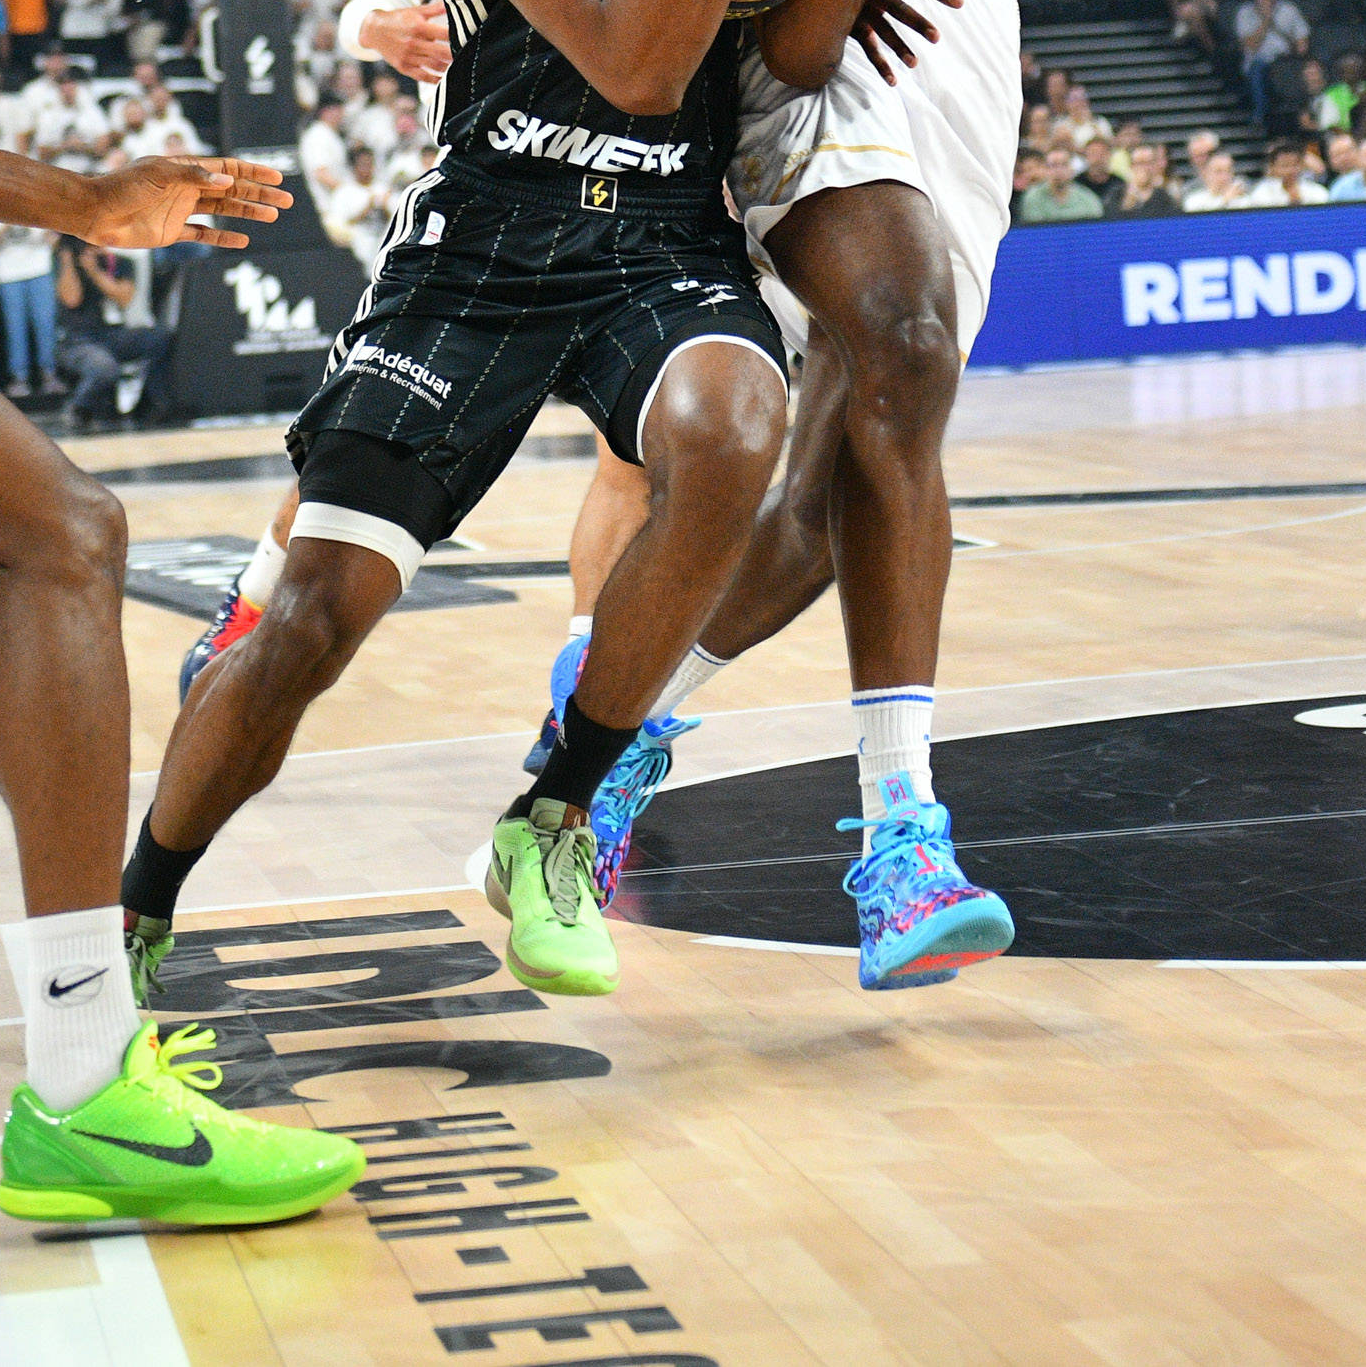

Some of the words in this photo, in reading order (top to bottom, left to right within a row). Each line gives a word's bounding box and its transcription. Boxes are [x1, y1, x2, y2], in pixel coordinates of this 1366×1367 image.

[368, 347, 453, 399] Adéquat
[379, 369, 388, 379] &
[389, 372, 443, 411] Recrutement
[315, 1111, 720, 1367] HIGH-TE
